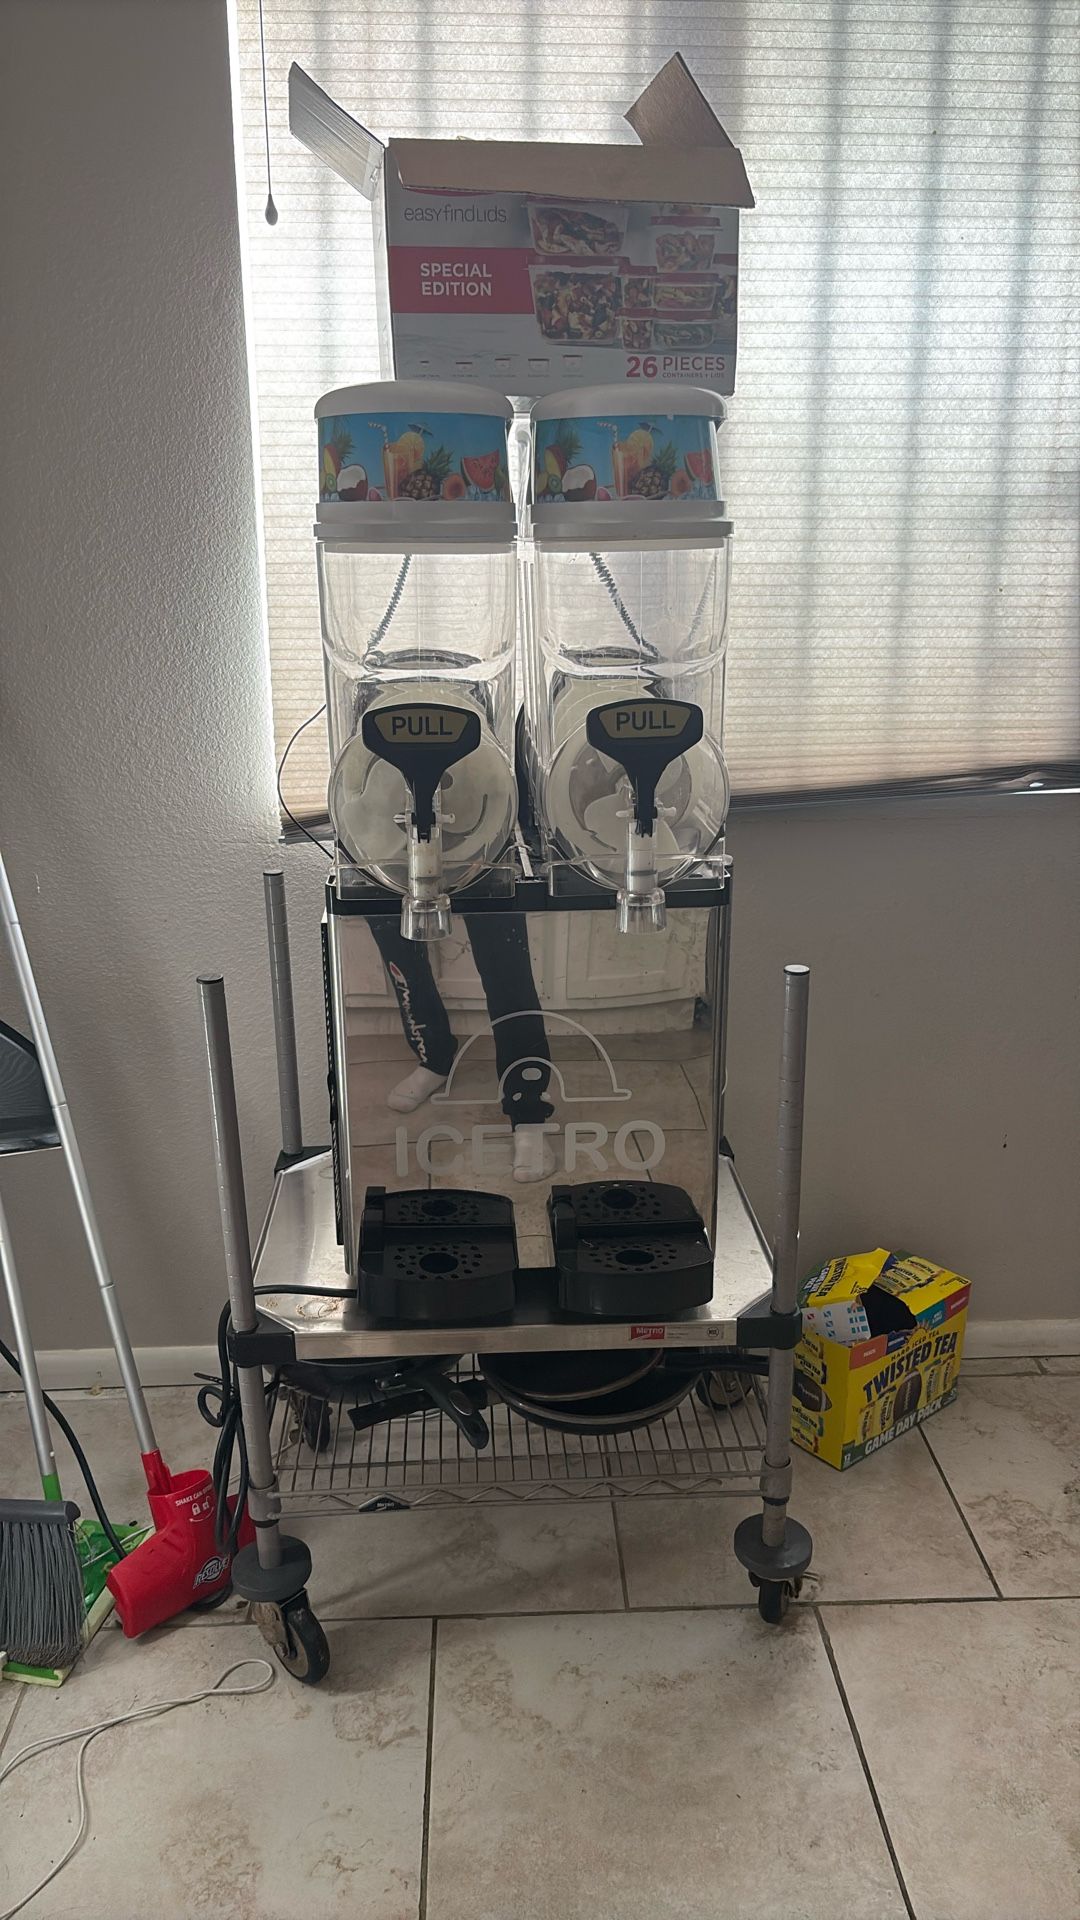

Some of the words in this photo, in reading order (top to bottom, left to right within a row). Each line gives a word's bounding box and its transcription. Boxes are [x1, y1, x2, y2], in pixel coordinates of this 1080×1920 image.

[420, 262, 493, 278] SPECIAL
[421, 281, 493, 297] EDITION
[626, 356, 659, 378] 26
[663, 356, 726, 371] PIECES
[391, 715, 453, 737] PULL
[615, 710, 677, 732] PULL
[395, 1119, 667, 1178] ICETRO
[891, 1346, 910, 1361] HARD
[929, 1329, 940, 1339] TEA
[863, 1340, 932, 1403] TWISTED
[933, 1331, 959, 1358] TEA
[865, 1427, 896, 1455] GAME
[896, 1412, 917, 1437] DAY
[917, 1396, 943, 1423] PACK
[175, 1495, 193, 1507] SHAKE
